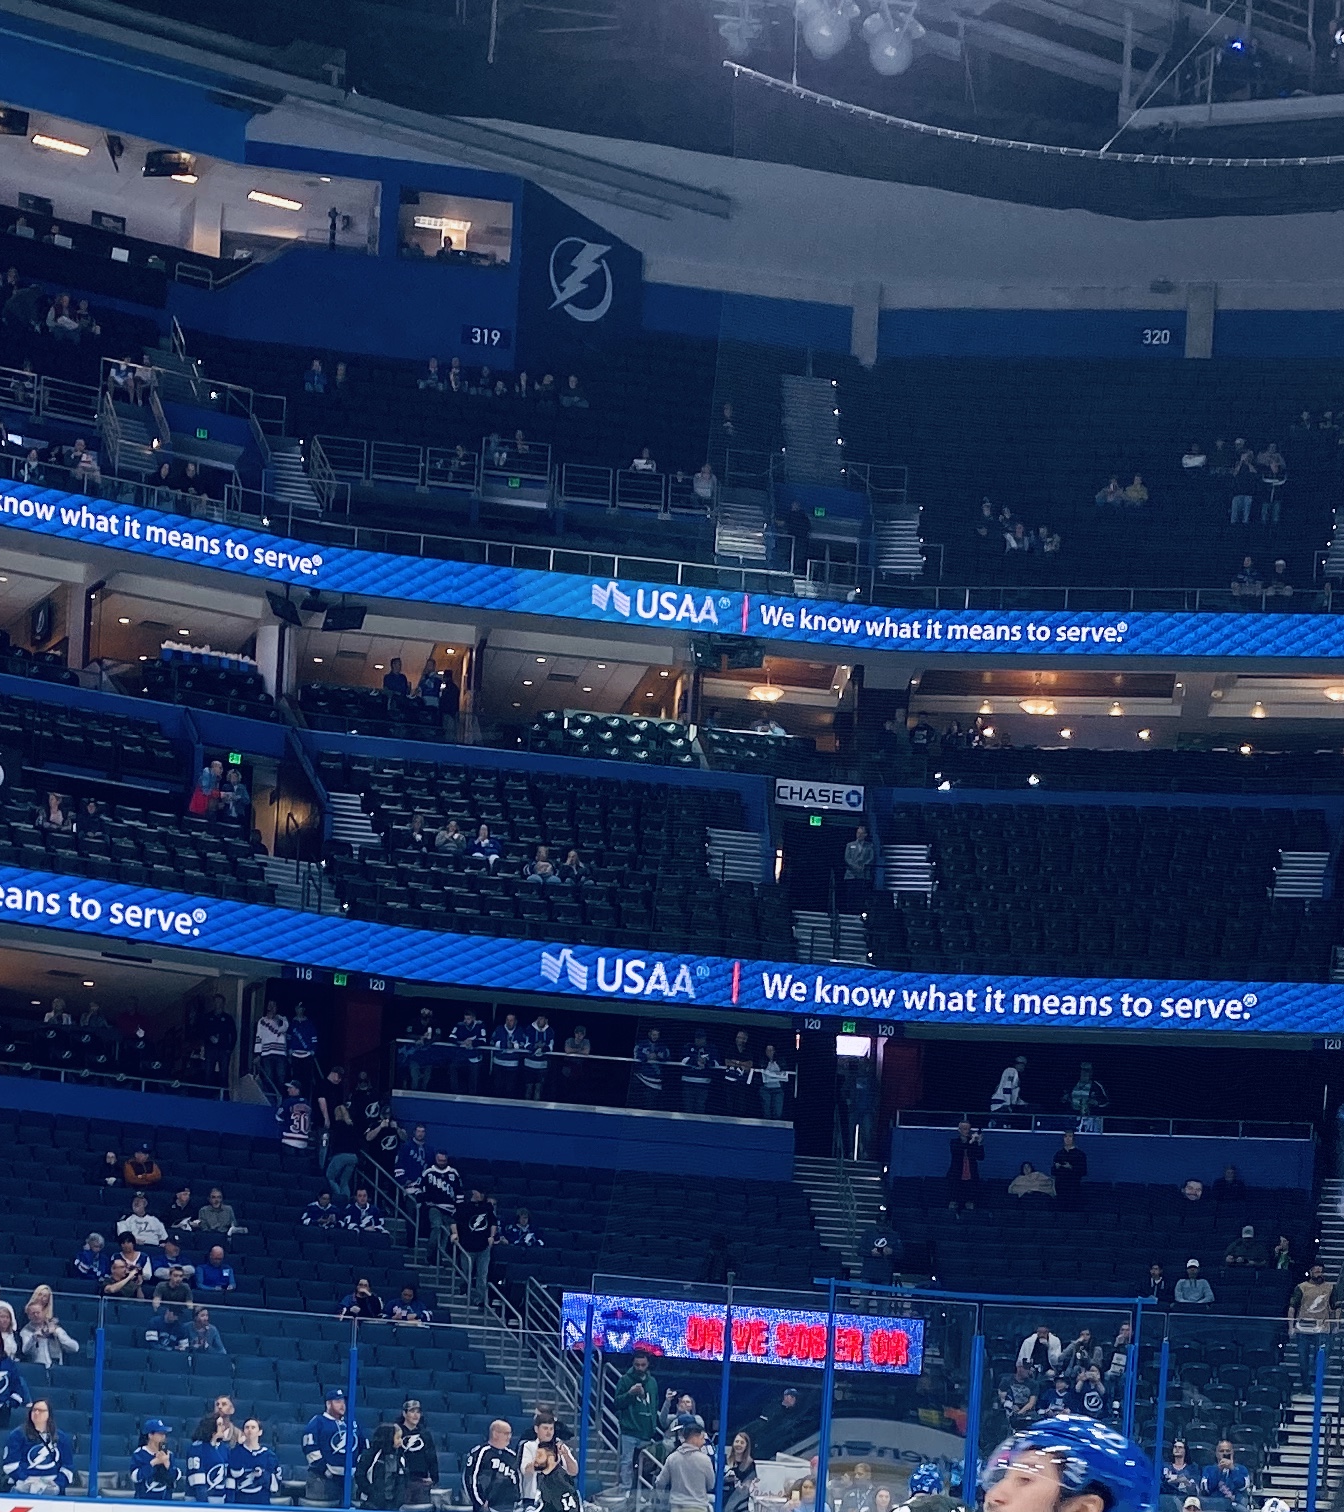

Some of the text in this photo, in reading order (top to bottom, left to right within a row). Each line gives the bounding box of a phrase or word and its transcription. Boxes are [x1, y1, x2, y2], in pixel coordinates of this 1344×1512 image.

[471, 328, 500, 346] 319
[1142, 329, 1170, 345] 320
[60, 505, 120, 535] what
[124, 515, 141, 540] it
[145, 525, 221, 555] means
[224, 538, 249, 561] to
[760, 604, 795, 628] We
[799, 607, 862, 634] know
[865, 616, 922, 639] what
[926, 618, 943, 640] it
[946, 624, 1022, 641] means
[1026, 622, 1051, 642] to
[776, 785, 844, 805] CHASE
[68, 892, 102, 921] to
[295, 968, 313, 981] 118
[369, 978, 386, 991] 120
[762, 972, 808, 1002] We
[814, 975, 896, 1009] know
[902, 983, 978, 1012] what
[984, 985, 1006, 1014] it
[1013, 993, 1113, 1017] means
[1120, 993, 1153, 1018] to
[804, 1018, 822, 1030] 120
[877, 1024, 895, 1036] 120
[1324, 1039, 1342, 1050] 120
